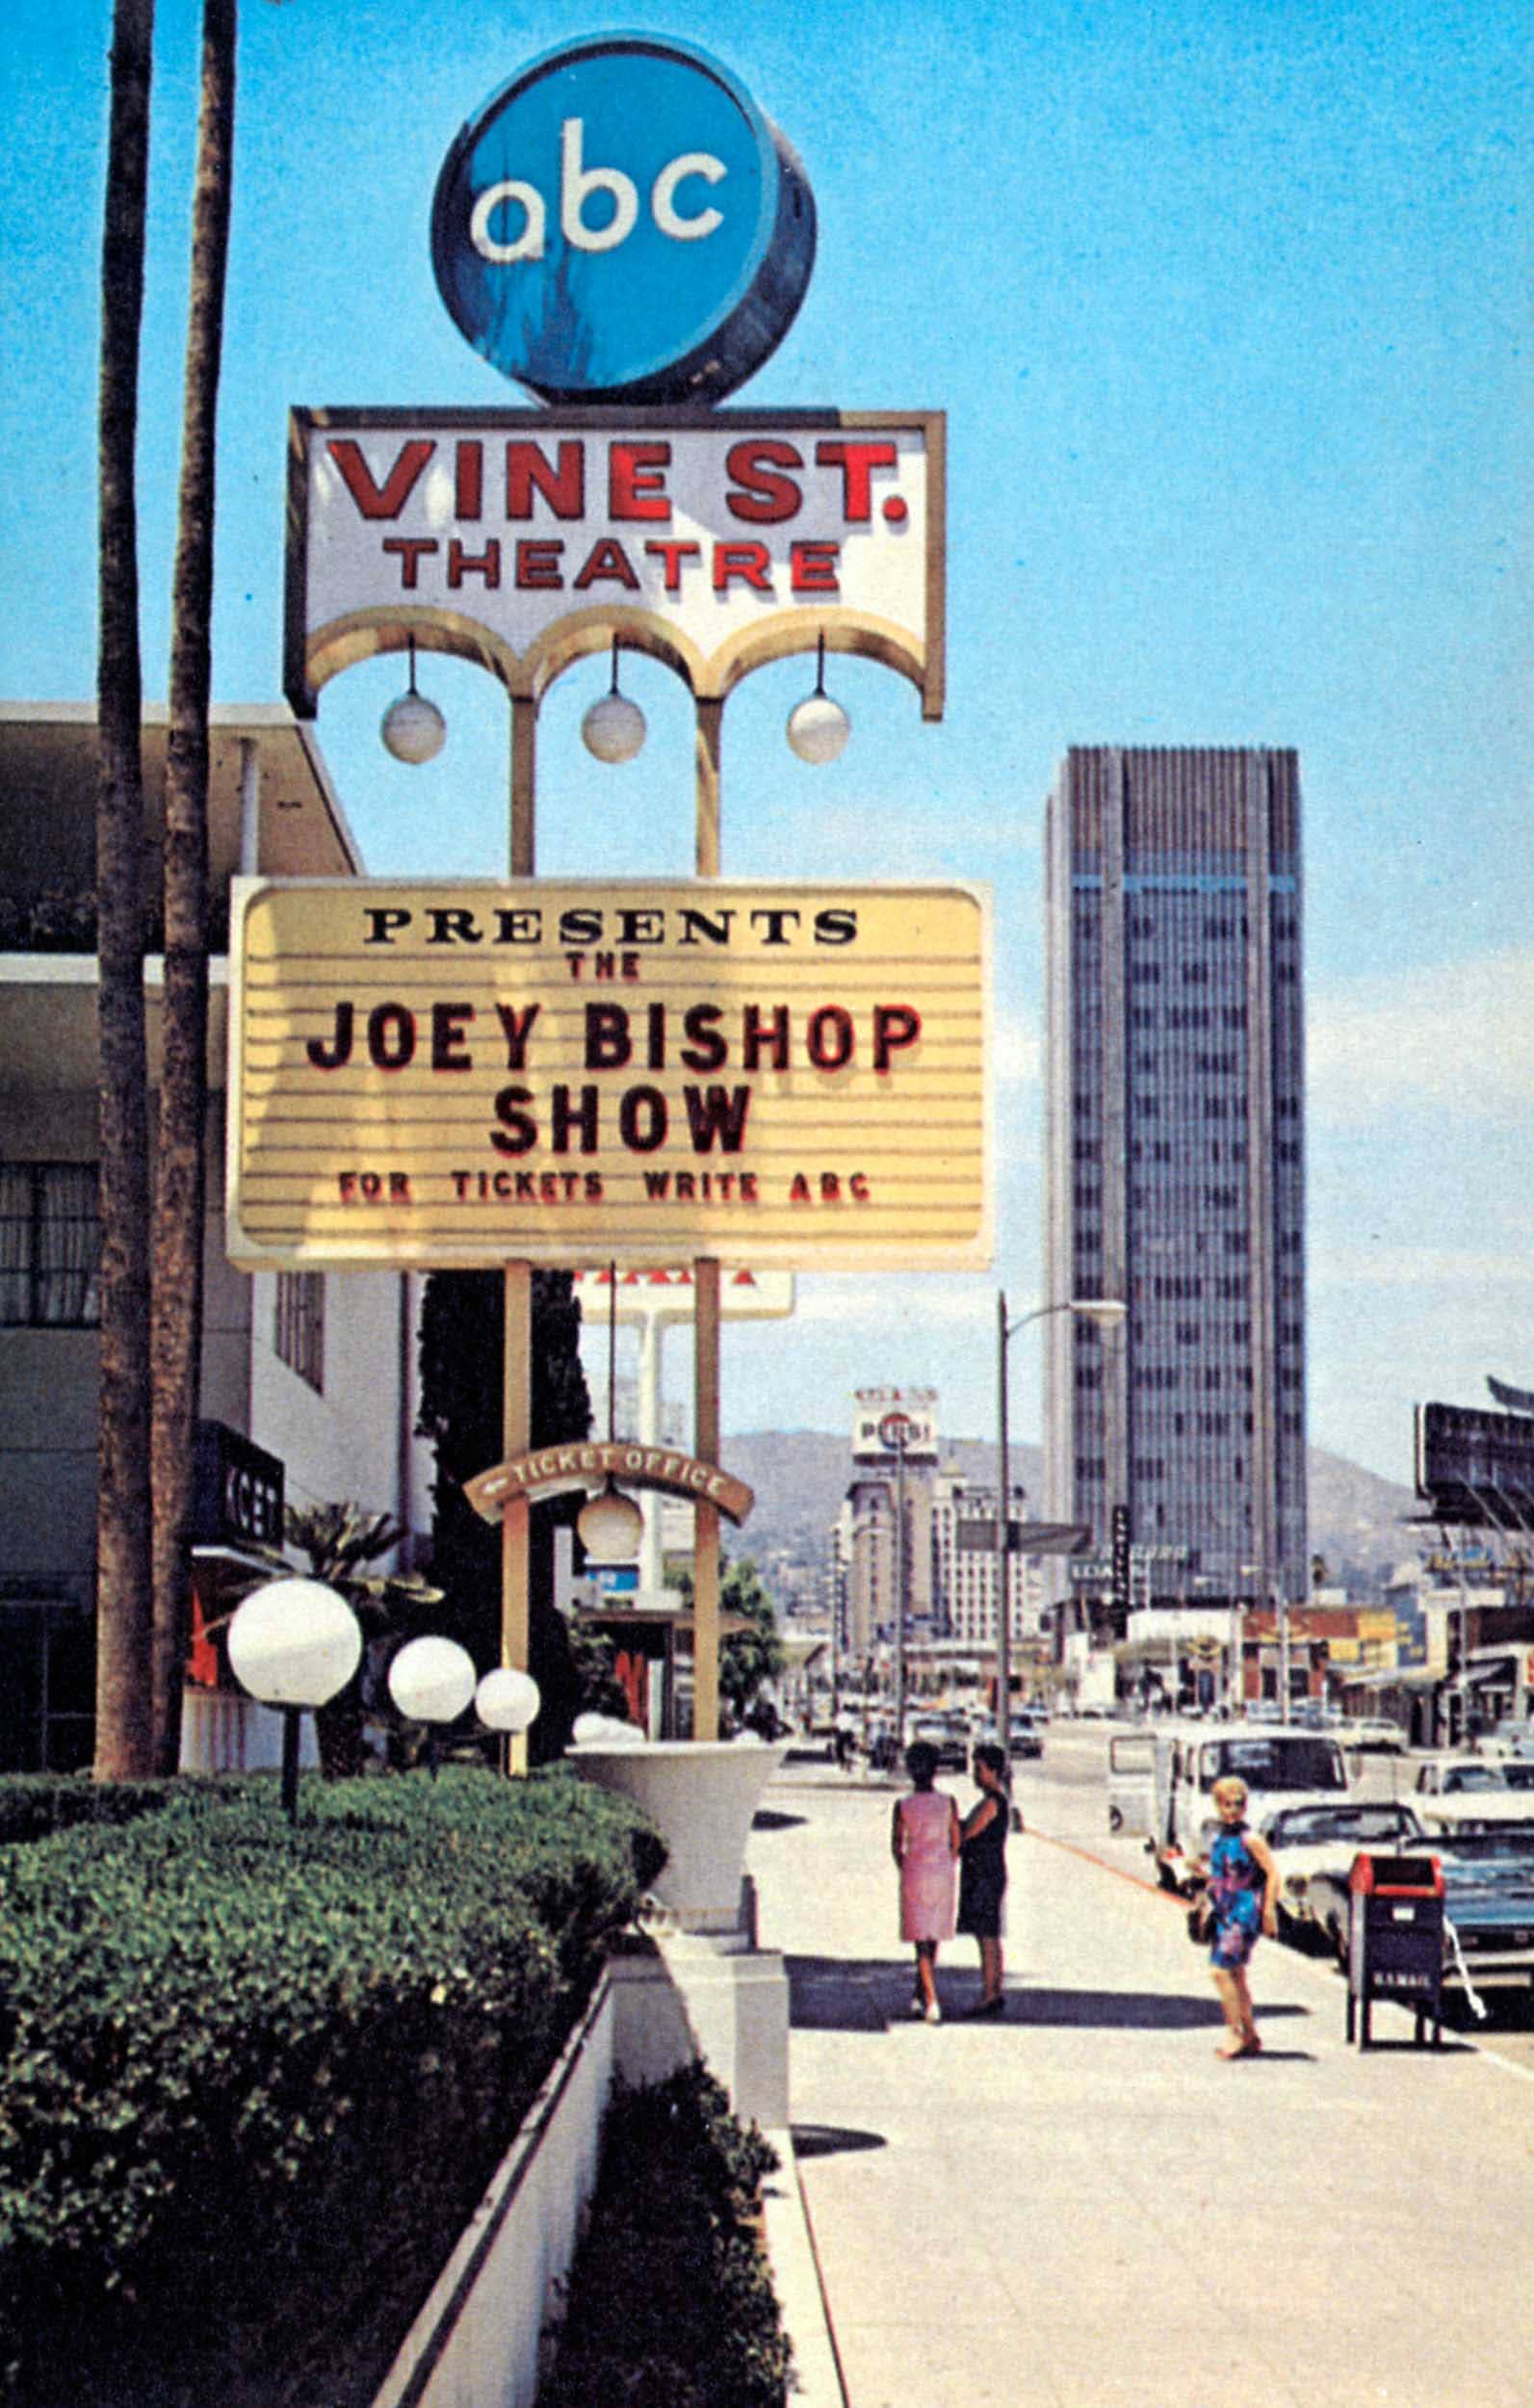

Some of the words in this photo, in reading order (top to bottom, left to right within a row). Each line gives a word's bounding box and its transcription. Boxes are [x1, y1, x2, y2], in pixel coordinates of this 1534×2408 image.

[470, 117, 728, 263] abc
[326, 439, 672, 521] VINE
[724, 440, 909, 526] ST.
[381, 537, 841, 593] THEATRE
[362, 908, 859, 945] PRESENTS
[566, 951, 640, 981] THE
[306, 1002, 541, 1073] JOEY
[585, 1004, 923, 1075] BISHOP
[491, 1085, 752, 1158] SHOW
[338, 1171, 410, 1204] FOR
[452, 1171, 604, 1204] TICKETS
[644, 1172, 759, 1204] WRITE
[790, 1172, 871, 1203] ABC
[860, 1423, 931, 1441] PSI
[513, 1448, 613, 1484] TICKET
[625, 1450, 727, 1495] OFFICE
